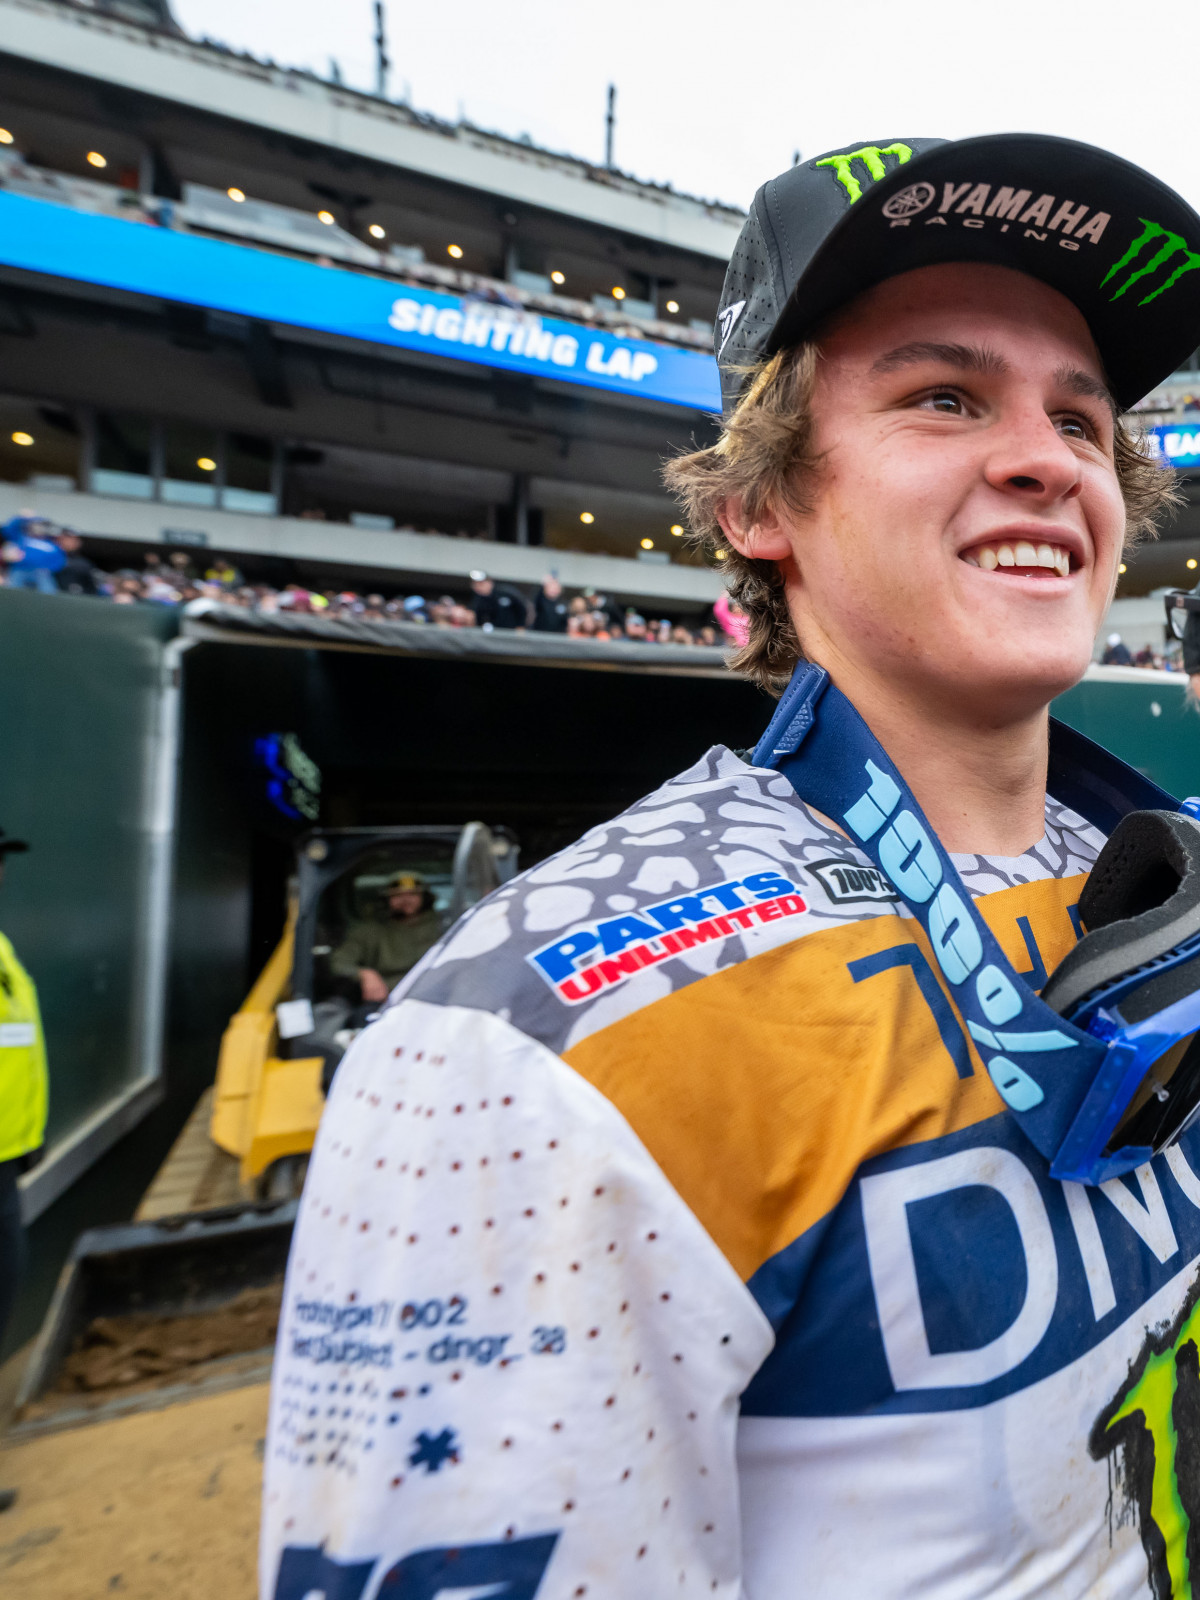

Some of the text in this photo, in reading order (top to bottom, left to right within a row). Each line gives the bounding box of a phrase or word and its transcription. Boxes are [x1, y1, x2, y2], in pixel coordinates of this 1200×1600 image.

[889, 216, 1080, 251] RACING
[937, 182, 1112, 245] YAMAHA
[388, 298, 658, 381] SIGHTING LAP
[829, 868, 895, 894] 100%
[533, 871, 800, 983] PARTS
[558, 894, 808, 1001] UNLIMITED
[843, 758, 1080, 1112] 100%
